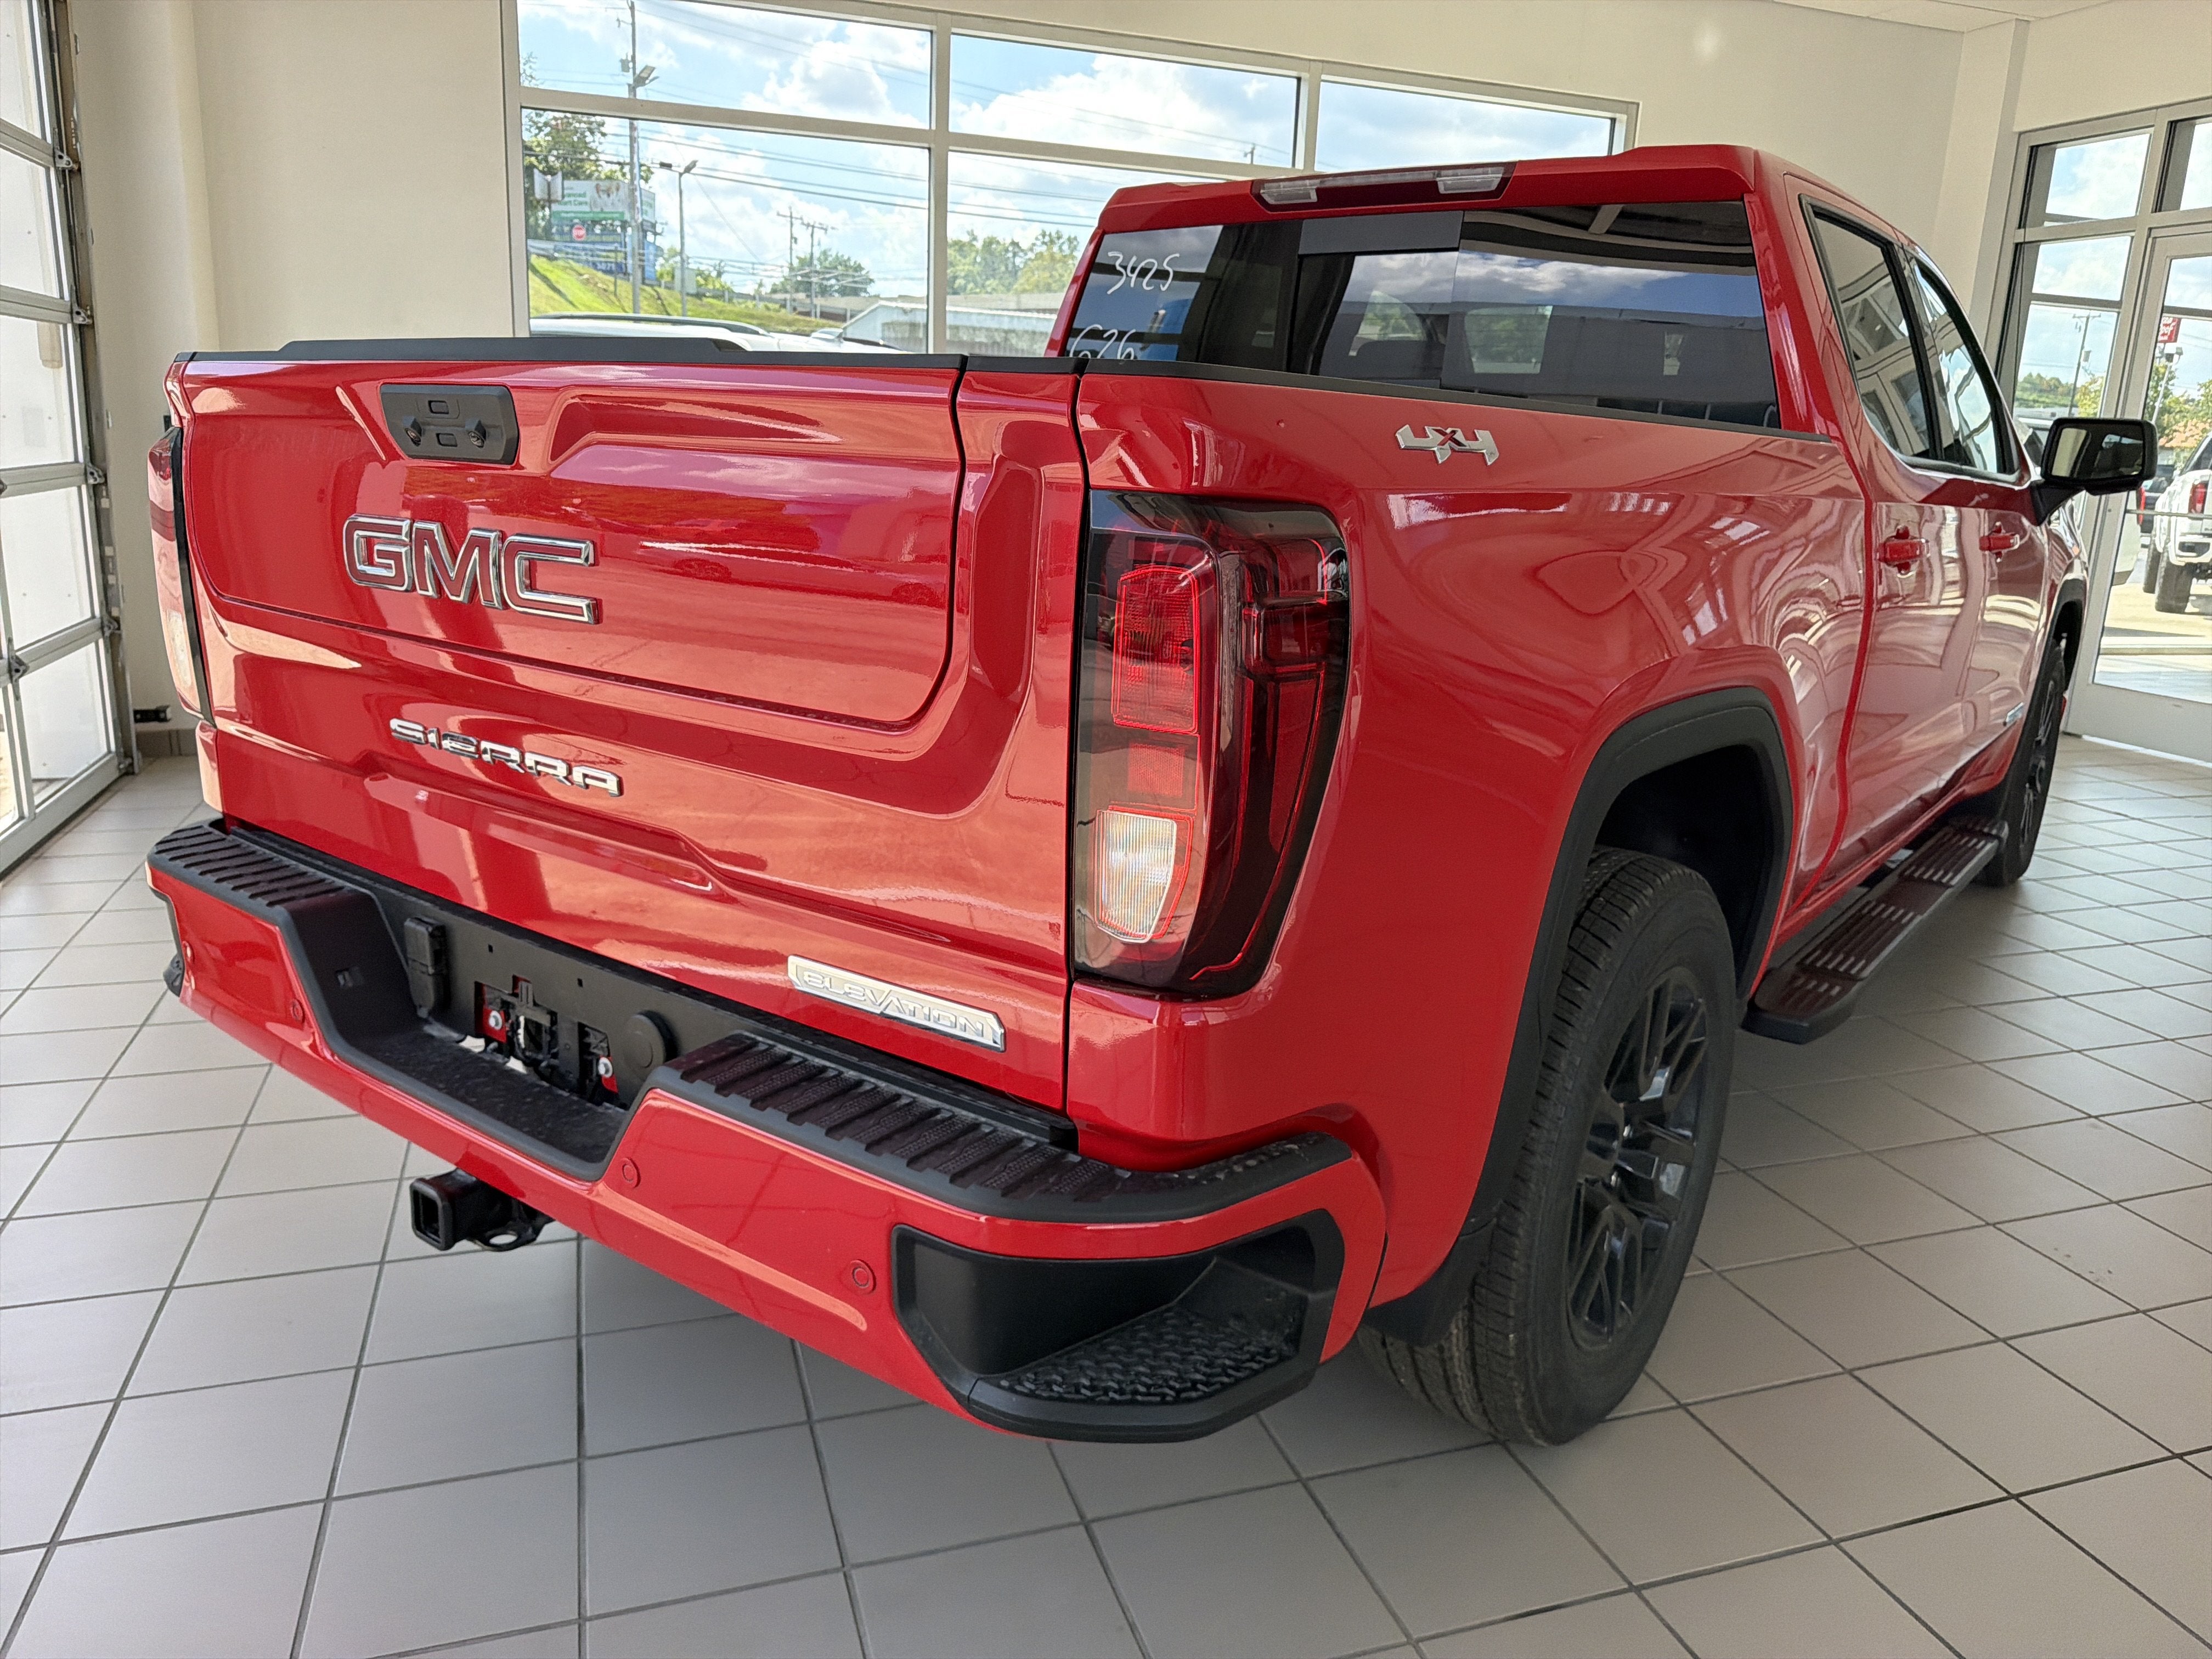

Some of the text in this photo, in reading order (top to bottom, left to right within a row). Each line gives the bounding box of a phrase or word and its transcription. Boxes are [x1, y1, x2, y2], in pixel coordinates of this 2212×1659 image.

[1107, 251, 1180, 295] 3425
[342, 513, 599, 624] GMC
[390, 717, 624, 797] SIERRA
[803, 970, 984, 1038] ELEVATION
